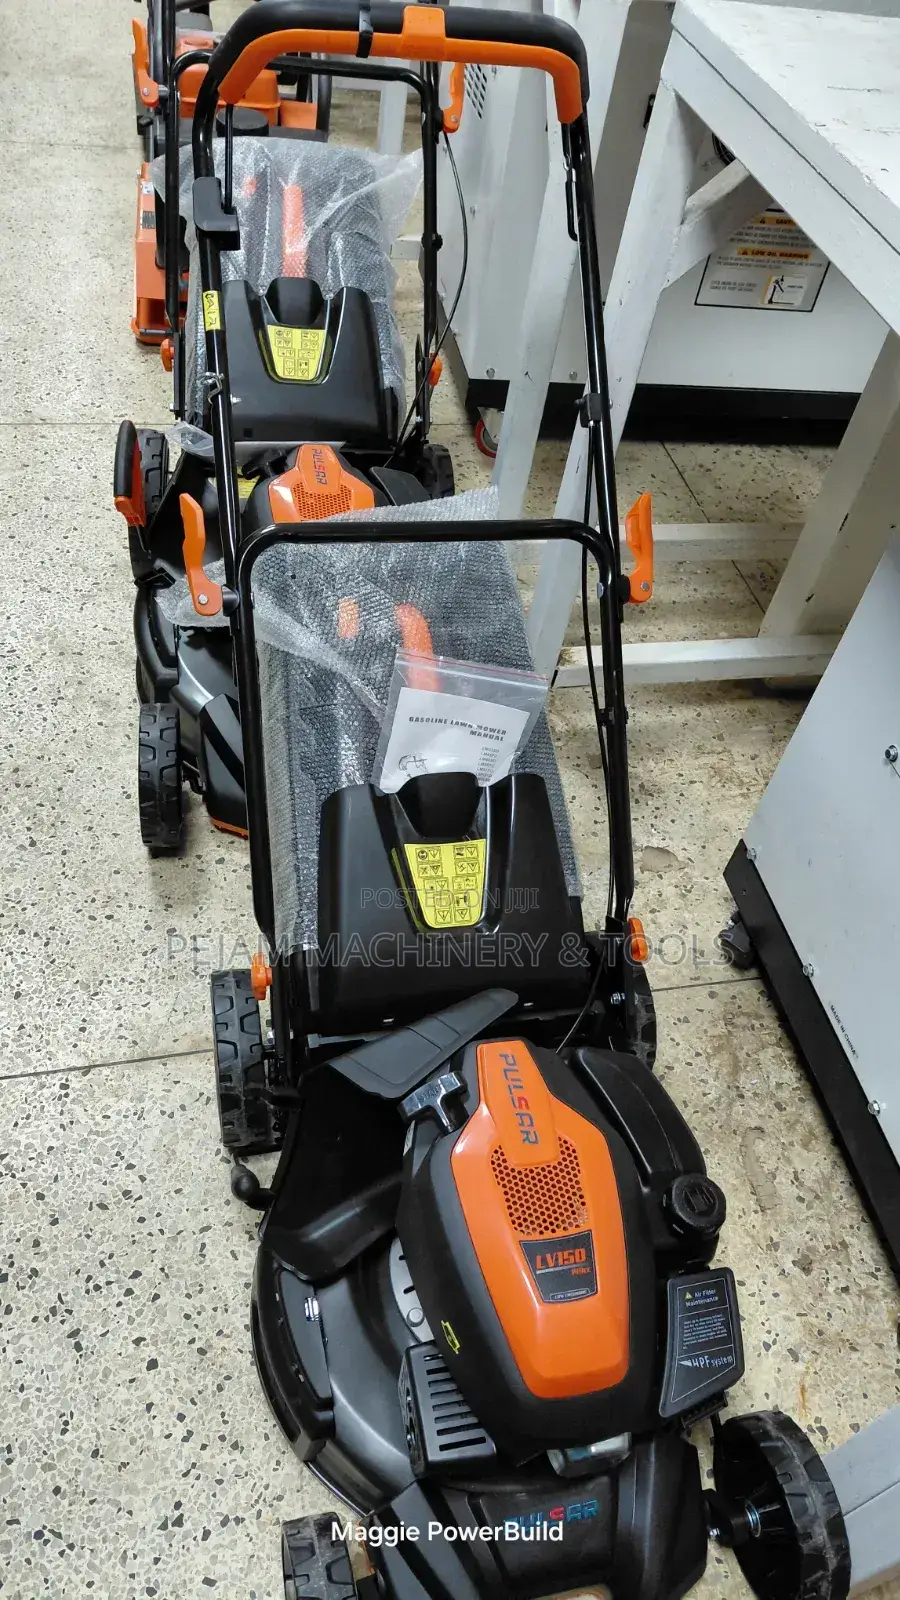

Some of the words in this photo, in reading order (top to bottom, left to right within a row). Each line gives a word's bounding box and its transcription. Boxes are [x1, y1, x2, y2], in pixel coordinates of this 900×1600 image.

[312, 448, 328, 485] PULSAR
[408, 716, 448, 725] GASOLINE
[450, 719, 473, 729] LAWN
[476, 725, 507, 735] MOWER
[469, 730, 504, 741] MANUAL
[830, 1004, 841, 1024] MADE
[844, 1033, 856, 1055] CHINA
[499, 1053, 539, 1144] PULSAR
[535, 1248, 587, 1270] LV150
[685, 1296, 718, 1307] Maintenance
[702, 1288, 716, 1296] Filter
[711, 1355, 733, 1368] system
